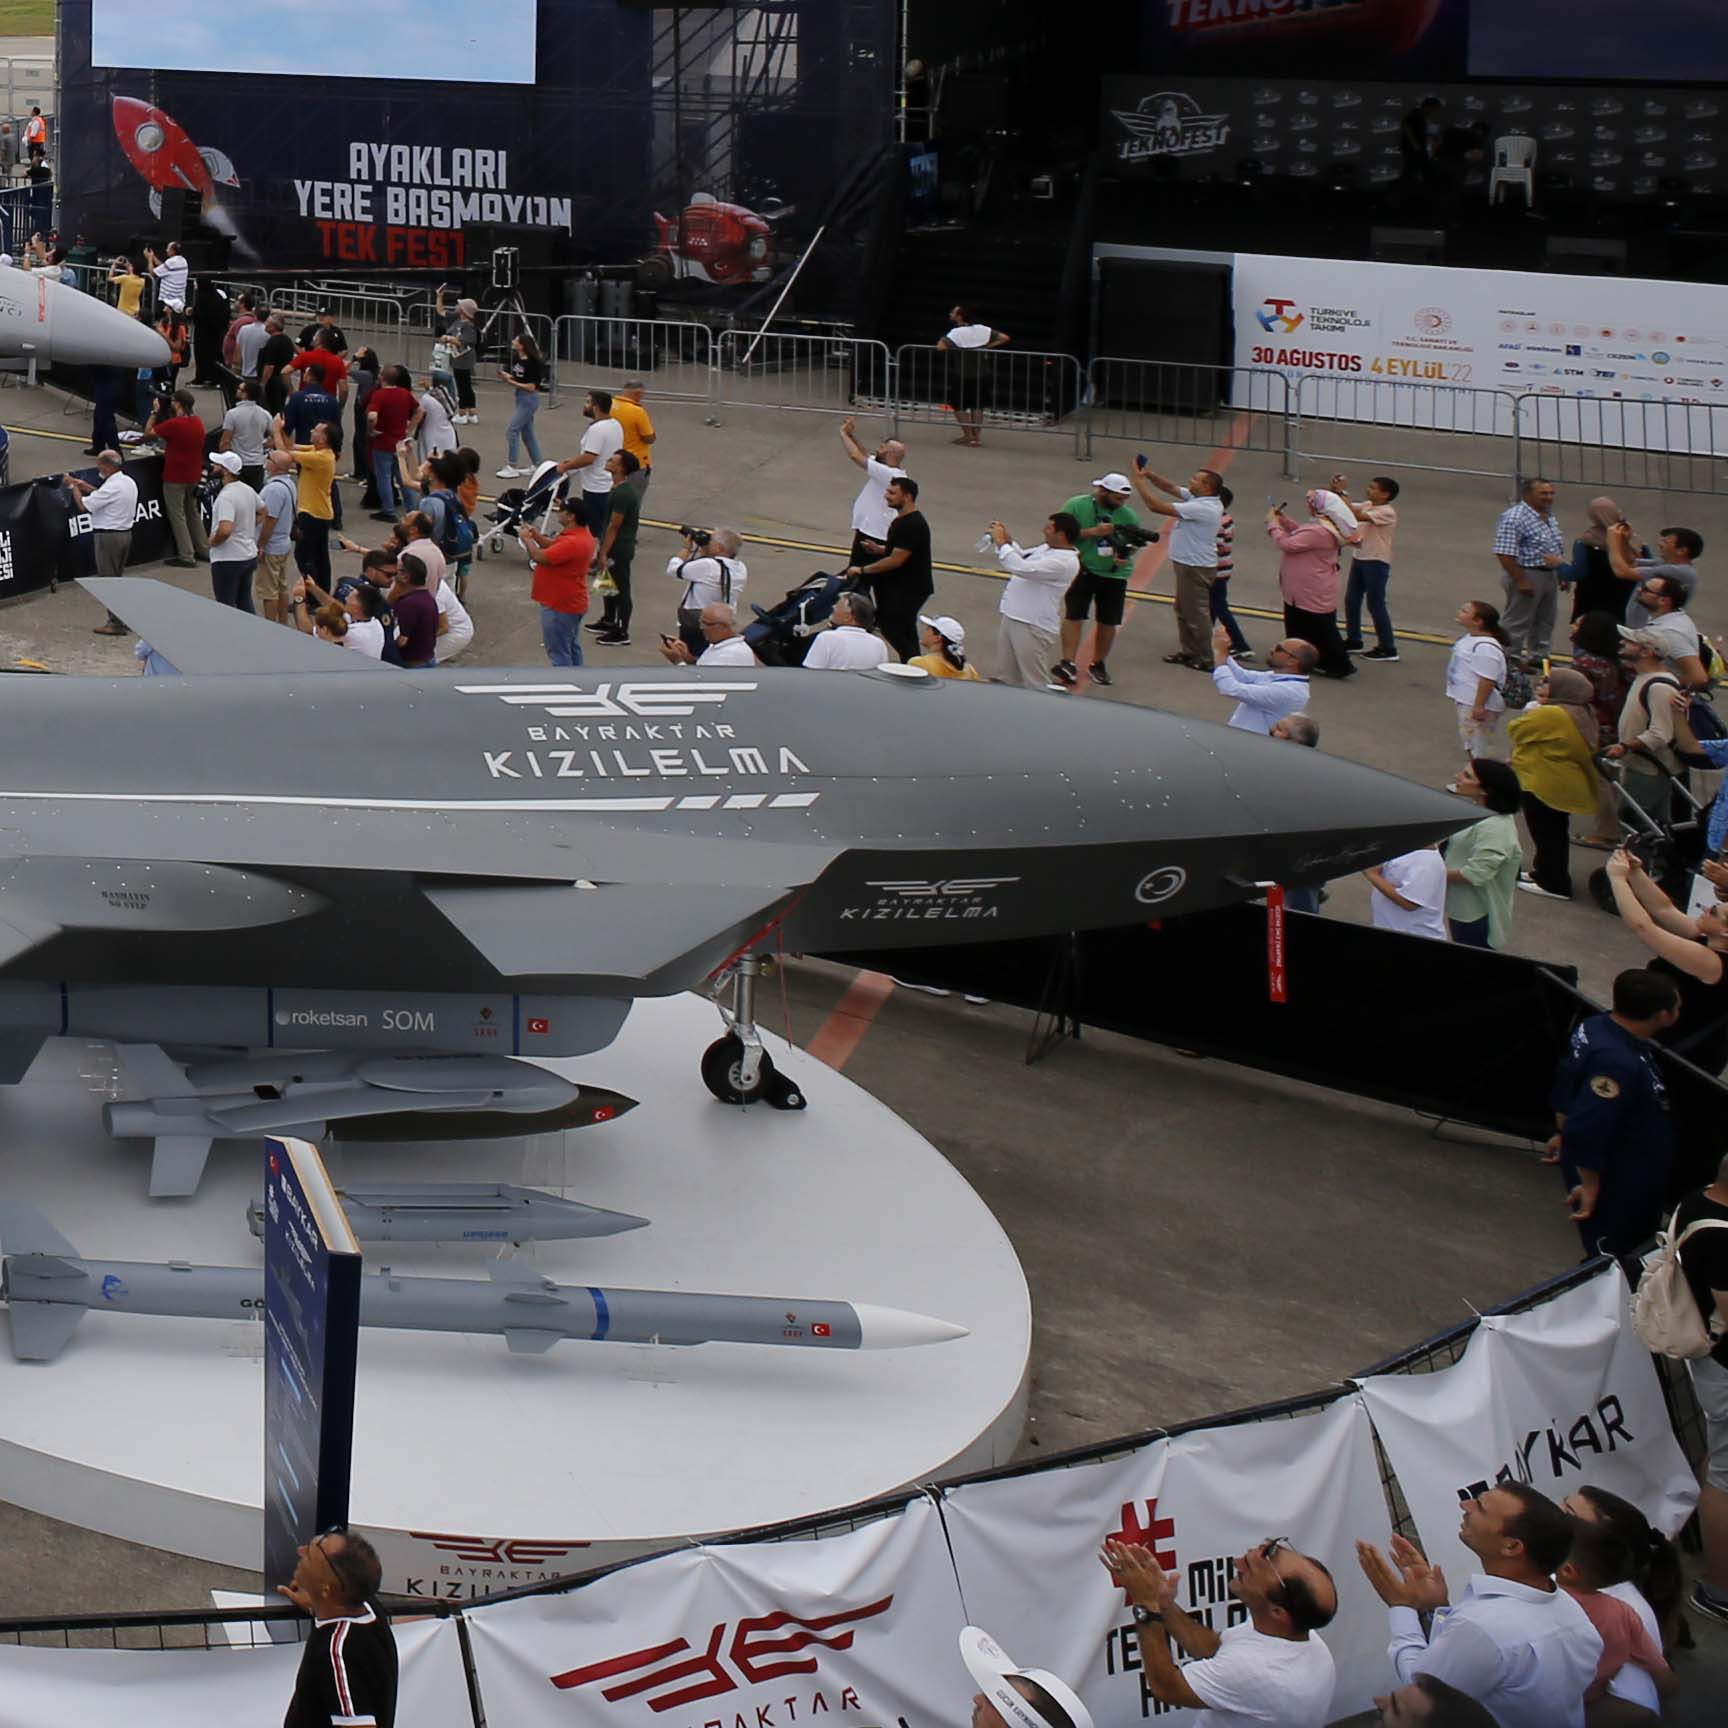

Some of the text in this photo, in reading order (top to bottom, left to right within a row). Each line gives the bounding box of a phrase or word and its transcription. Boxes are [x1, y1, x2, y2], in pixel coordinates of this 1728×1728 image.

[1118, 123, 1231, 160] TEKNOFEST
[349, 142, 507, 189] AYAKLARI
[295, 179, 374, 225] YERE
[315, 221, 376, 262] TEK
[1252, 346, 1273, 364] 30
[1276, 348, 1362, 373] AĞUSTOS
[1371, 357, 1383, 375] 4
[527, 724, 737, 741] BAYRAKTAR
[483, 746, 811, 779] KIZILELMA
[839, 906, 999, 920] KIZILELMA
[292, 1008, 435, 1032] roketsan SOM
